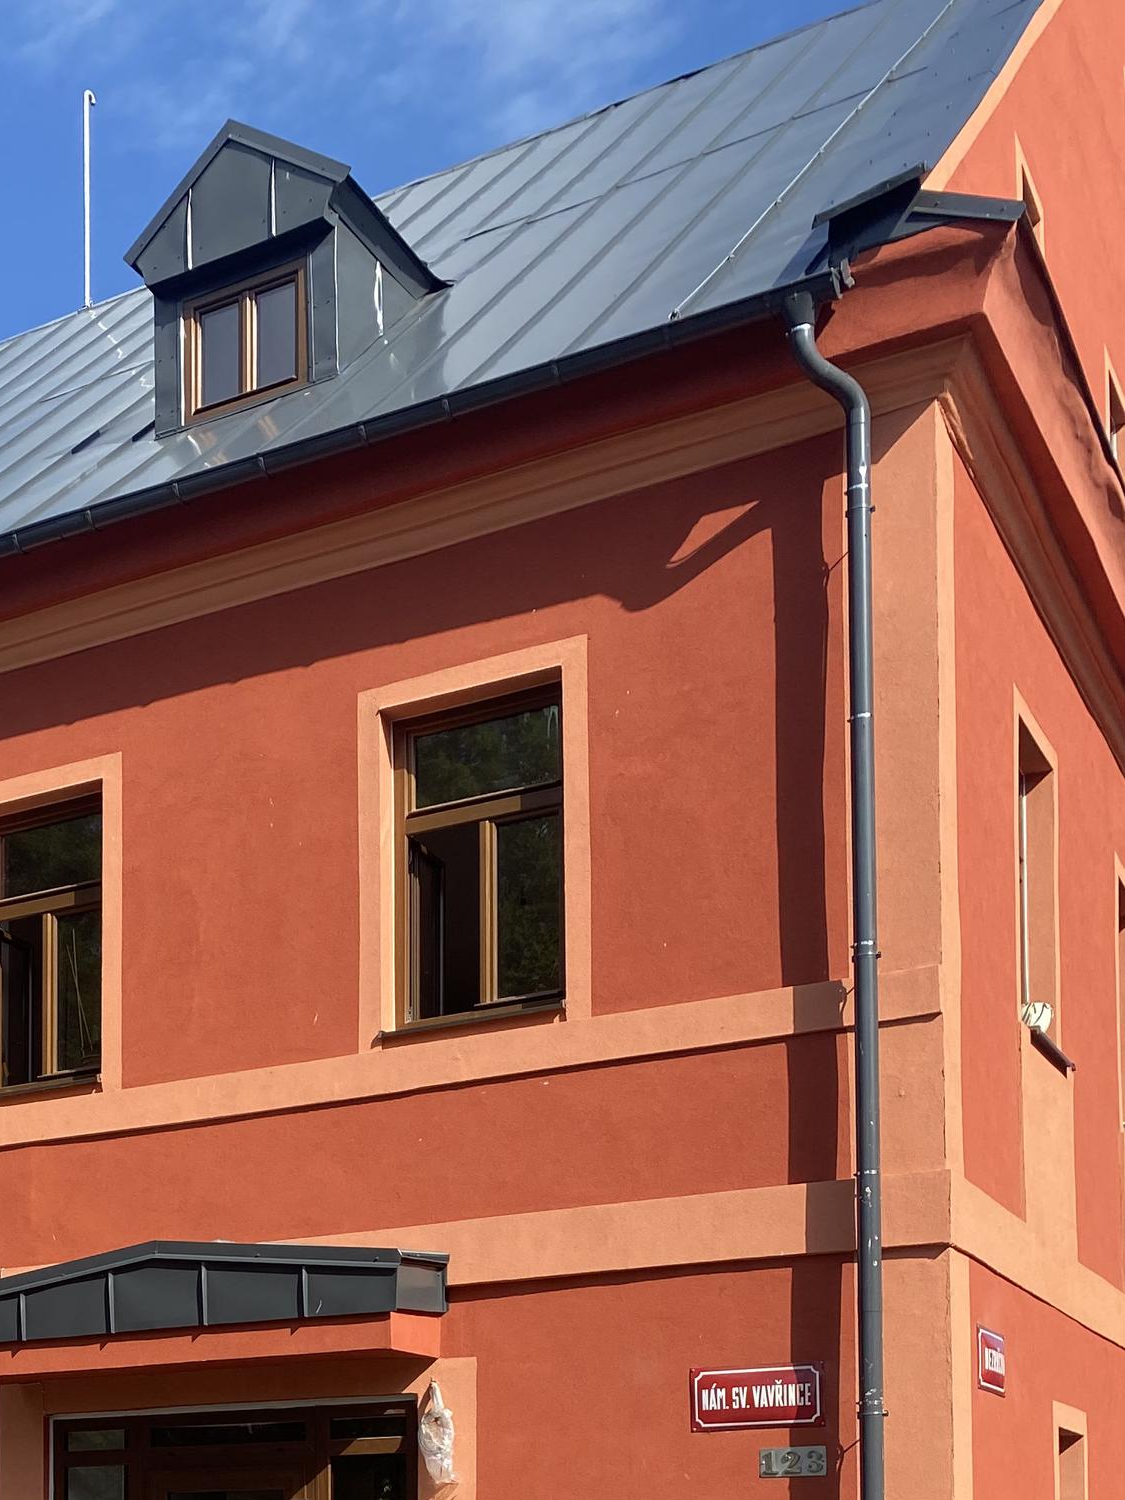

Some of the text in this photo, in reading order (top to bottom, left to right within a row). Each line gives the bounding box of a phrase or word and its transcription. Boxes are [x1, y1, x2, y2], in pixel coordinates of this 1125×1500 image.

[702, 1379, 811, 1411] NÁM. SV. VAVŘINCE
[762, 1450, 824, 1476] 123
